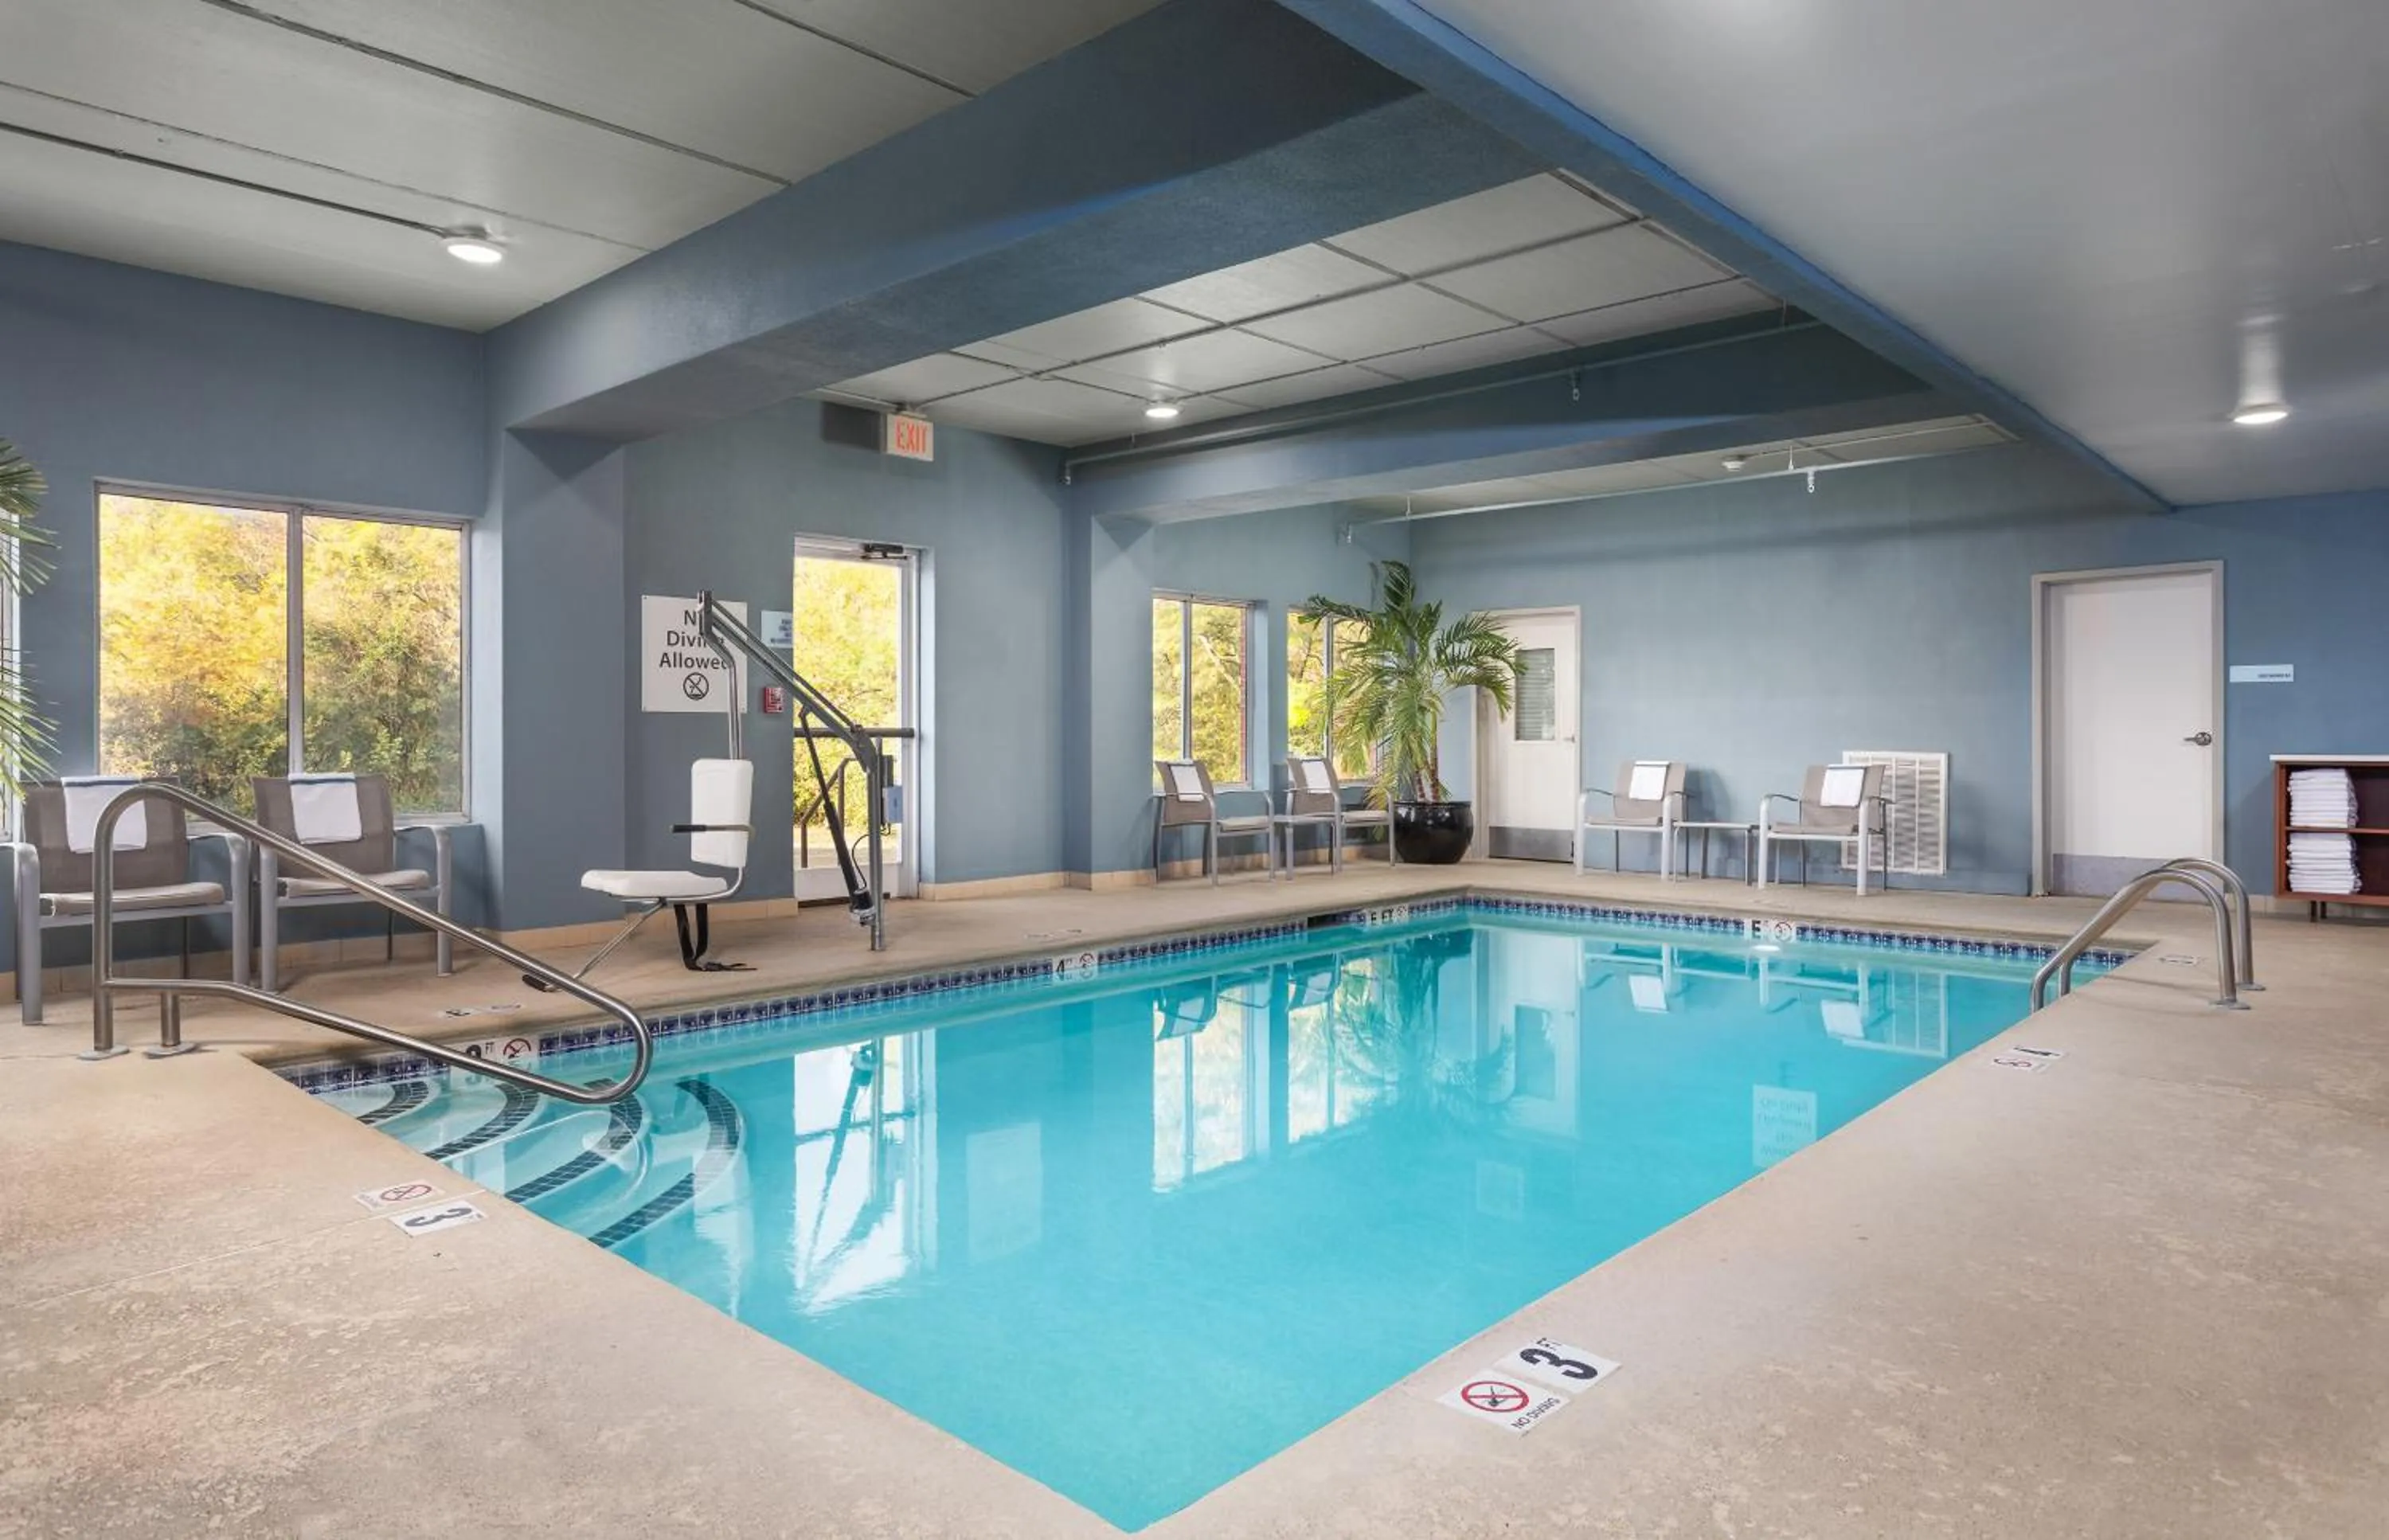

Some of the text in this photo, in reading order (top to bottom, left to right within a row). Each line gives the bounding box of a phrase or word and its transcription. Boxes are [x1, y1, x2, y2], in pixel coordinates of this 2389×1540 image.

[895, 415, 928, 455] EXIT
[1519, 1347, 1598, 1381] 3
[1511, 1417, 1530, 1429] NO
